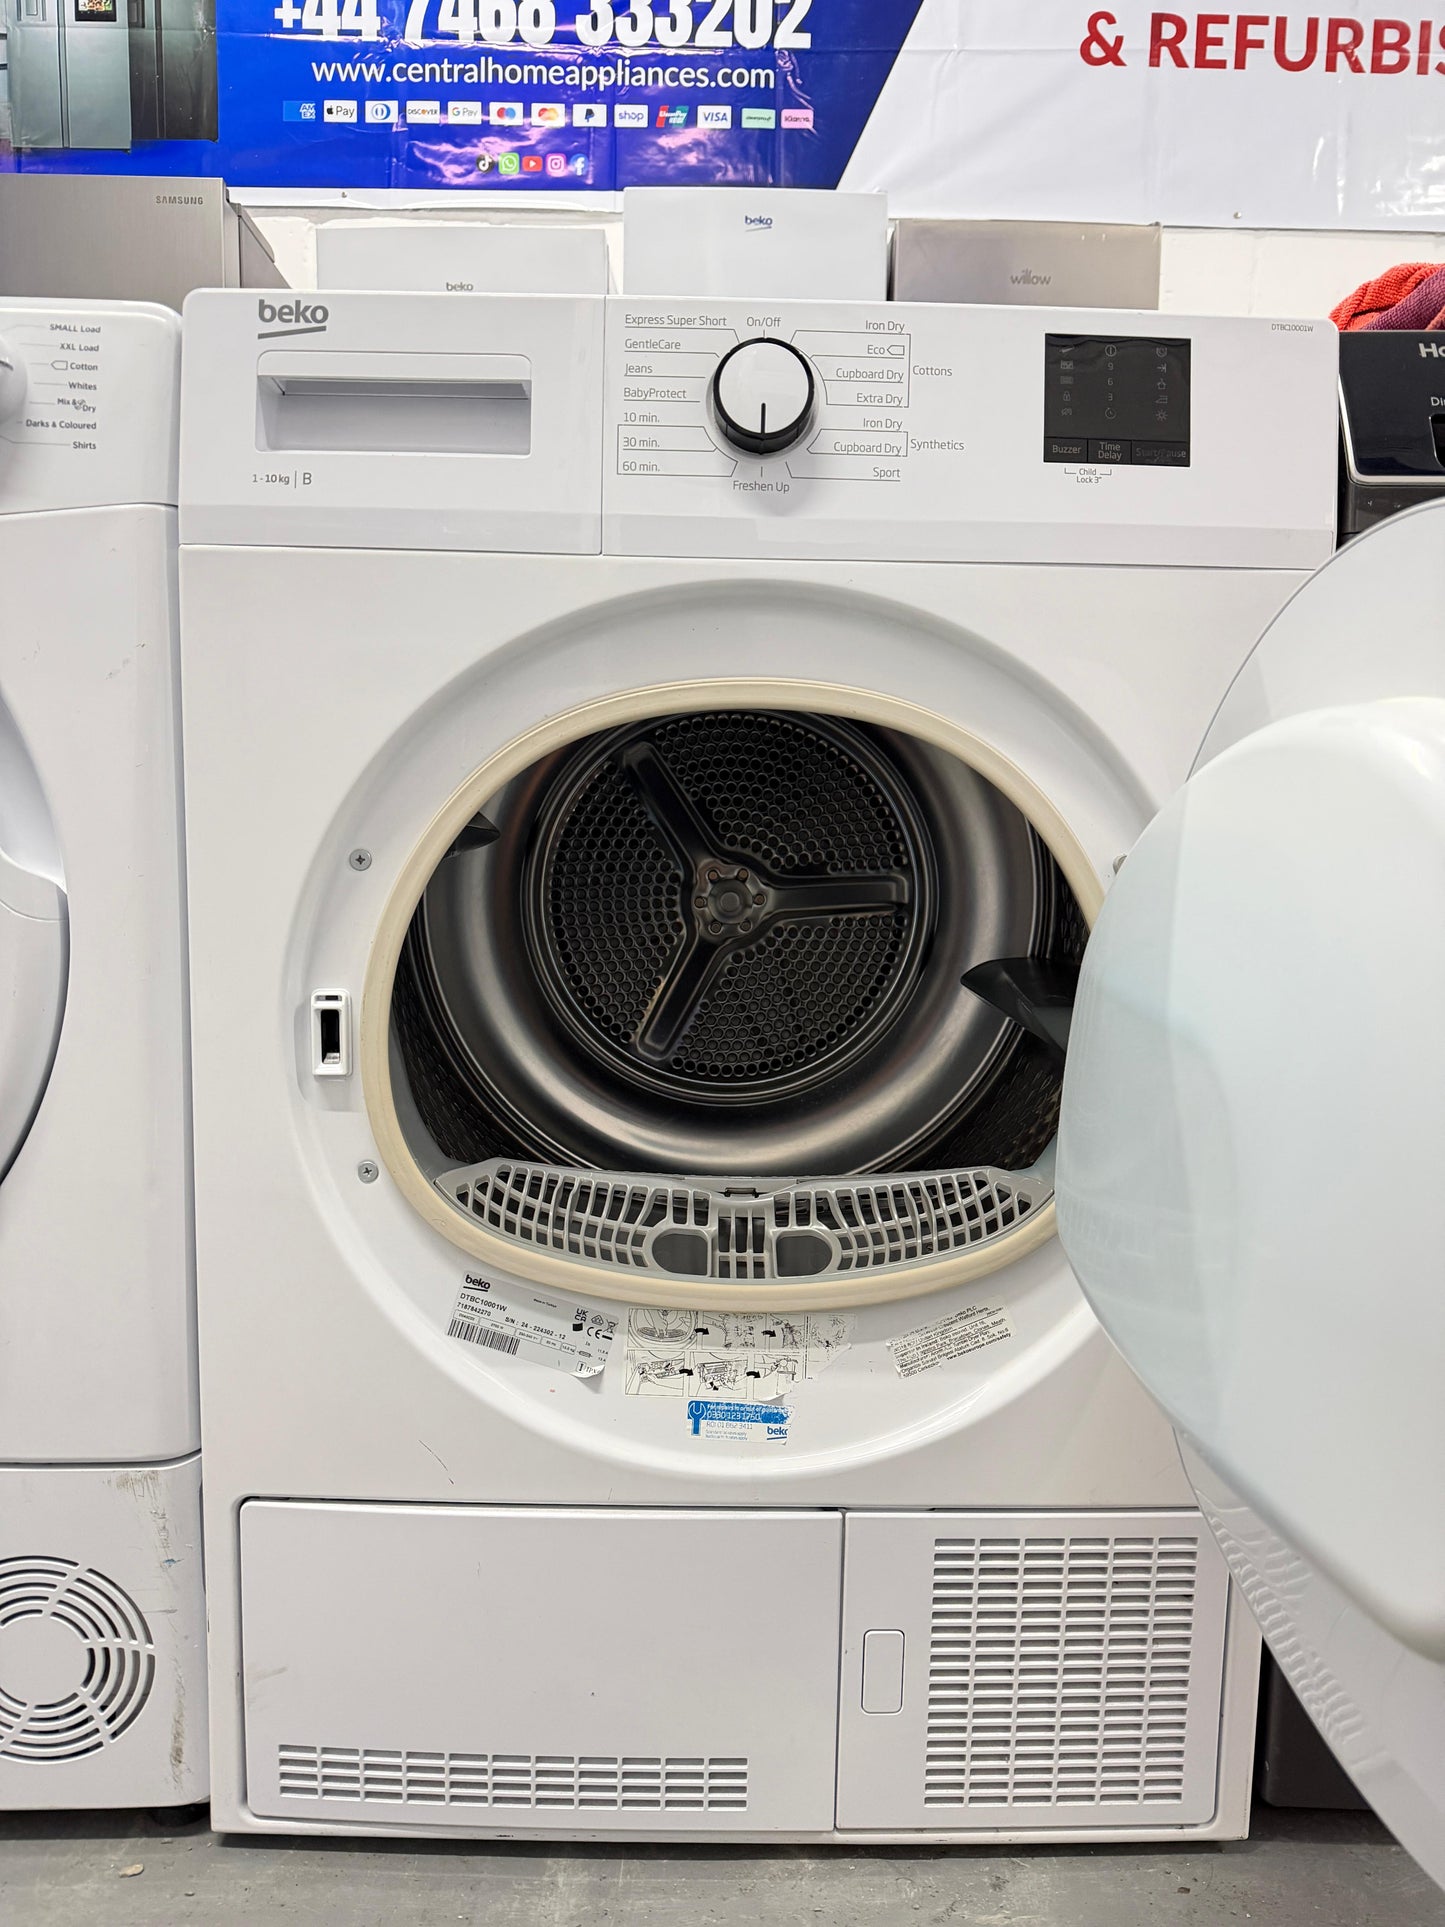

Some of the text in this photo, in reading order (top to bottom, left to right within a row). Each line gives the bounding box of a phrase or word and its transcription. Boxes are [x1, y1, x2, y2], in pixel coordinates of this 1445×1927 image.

[274, 0, 380, 39] +44
[576, 0, 812, 48] 333202
[1080, 10, 1445, 76] & REFURBI
[312, 57, 774, 91] www.centralhomeappliances.com
[336, 105, 355, 118] Pay
[618, 110, 644, 122] shop
[702, 113, 728, 122] VISA
[156, 196, 203, 205] SAMSUNG
[745, 215, 773, 225] beko
[1010, 268, 1051, 285] willow
[446, 282, 473, 291] beko
[258, 299, 329, 324] beko
[625, 314, 727, 326] Express Super Short
[747, 317, 781, 327] On/Off
[50, 324, 78, 332] SMALL
[865, 320, 905, 333] Iron Dry
[625, 339, 681, 350] GentleCare
[867, 345, 885, 355] Eco
[70, 363, 98, 371] Cotton
[624, 364, 653, 375] Jeans
[913, 365, 952, 376] Cottons
[836, 368, 904, 382] Cupboard Dry
[68, 381, 97, 390] Whites
[624, 387, 686, 400] BabyProtect
[856, 393, 903, 406] Extra Dry
[82, 405, 96, 413] Dry
[624, 412, 660, 423] 10 min.
[26, 419, 50, 428] Darks
[59, 420, 97, 429] Coloured
[863, 418, 902, 431] Iron Dry
[73, 442, 97, 450] Shirts
[623, 437, 660, 448] 30 min.
[910, 439, 965, 451] Synthetics
[1100, 442, 1121, 451] Time
[834, 442, 902, 456] Cupboard Dry
[1052, 445, 1081, 454] Buzzer
[1098, 451, 1122, 461] Delay
[622, 462, 660, 472] 60 min.
[303, 472, 312, 485] B
[873, 467, 901, 479] Sport
[733, 480, 790, 494] Freshen Up
[465, 1274, 491, 1289] beko
[460, 1292, 507, 1312] DTBC10001W
[576, 1308, 589, 1316] UK
